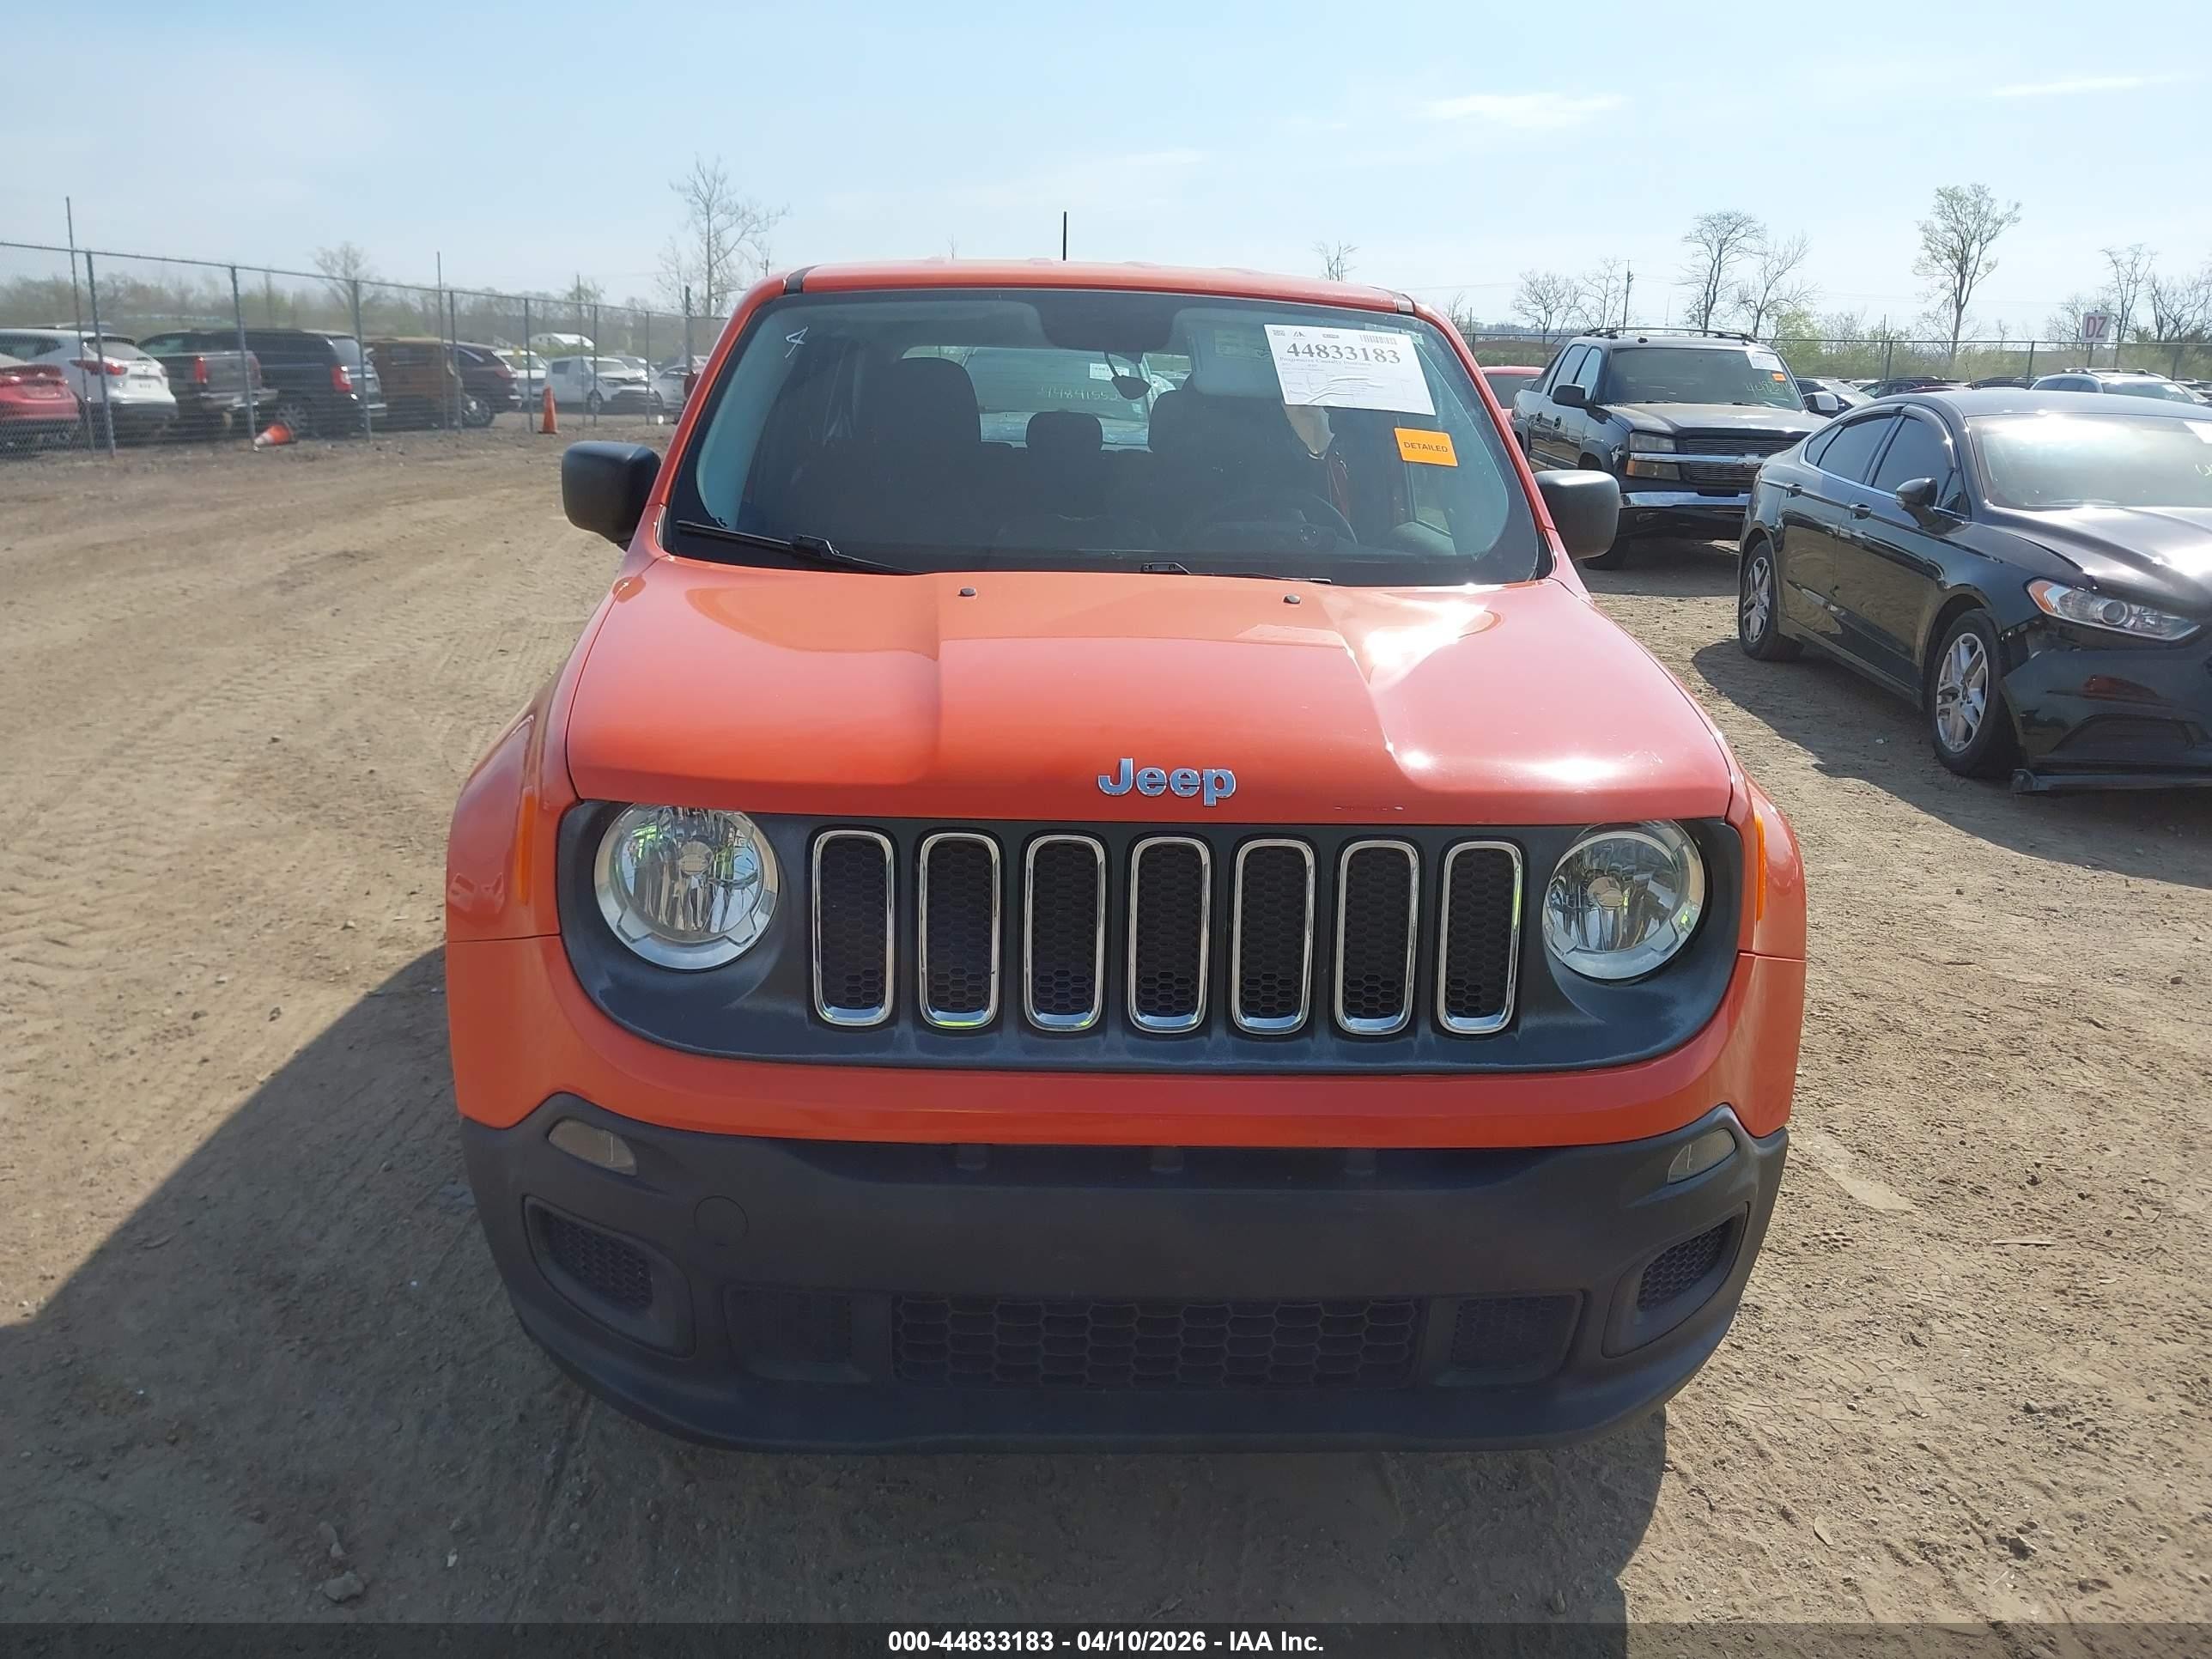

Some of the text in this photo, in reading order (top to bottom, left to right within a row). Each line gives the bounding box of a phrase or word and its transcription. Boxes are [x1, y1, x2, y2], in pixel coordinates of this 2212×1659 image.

[1287, 343, 1401, 364] 44833183
[1403, 441, 1449, 453] DETAILED
[1097, 757, 1237, 806] Jeep
